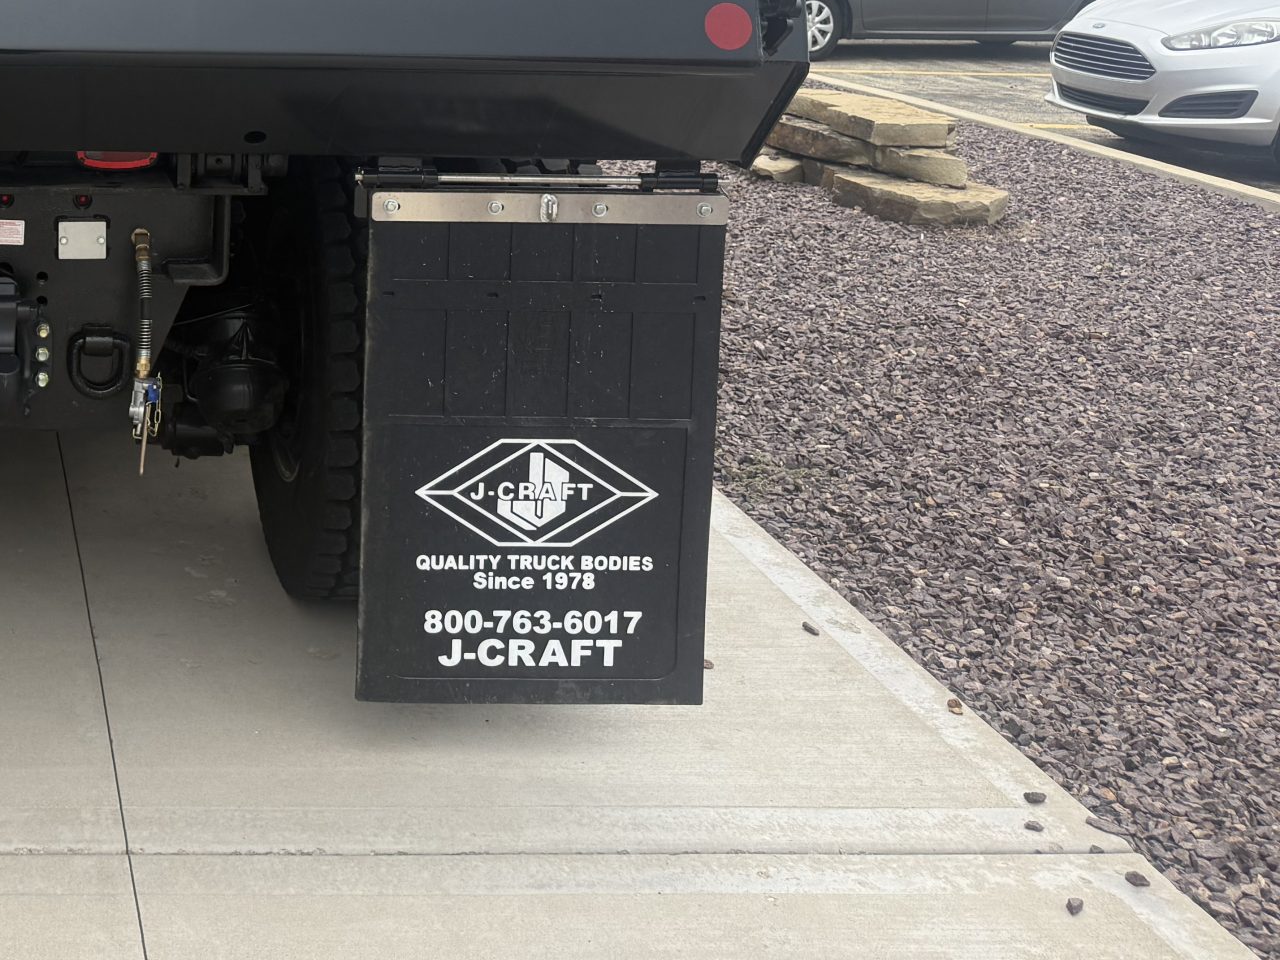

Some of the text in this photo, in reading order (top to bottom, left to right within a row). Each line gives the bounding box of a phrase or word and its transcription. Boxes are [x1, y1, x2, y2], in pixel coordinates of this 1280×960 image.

[469, 481, 594, 501] J-CRAFT
[415, 554, 654, 572] QUALITY TRUCK BODIES
[472, 571, 596, 590] Since 1978
[423, 609, 643, 635] 800-763-6017
[437, 638, 623, 667] J-CRAFT
